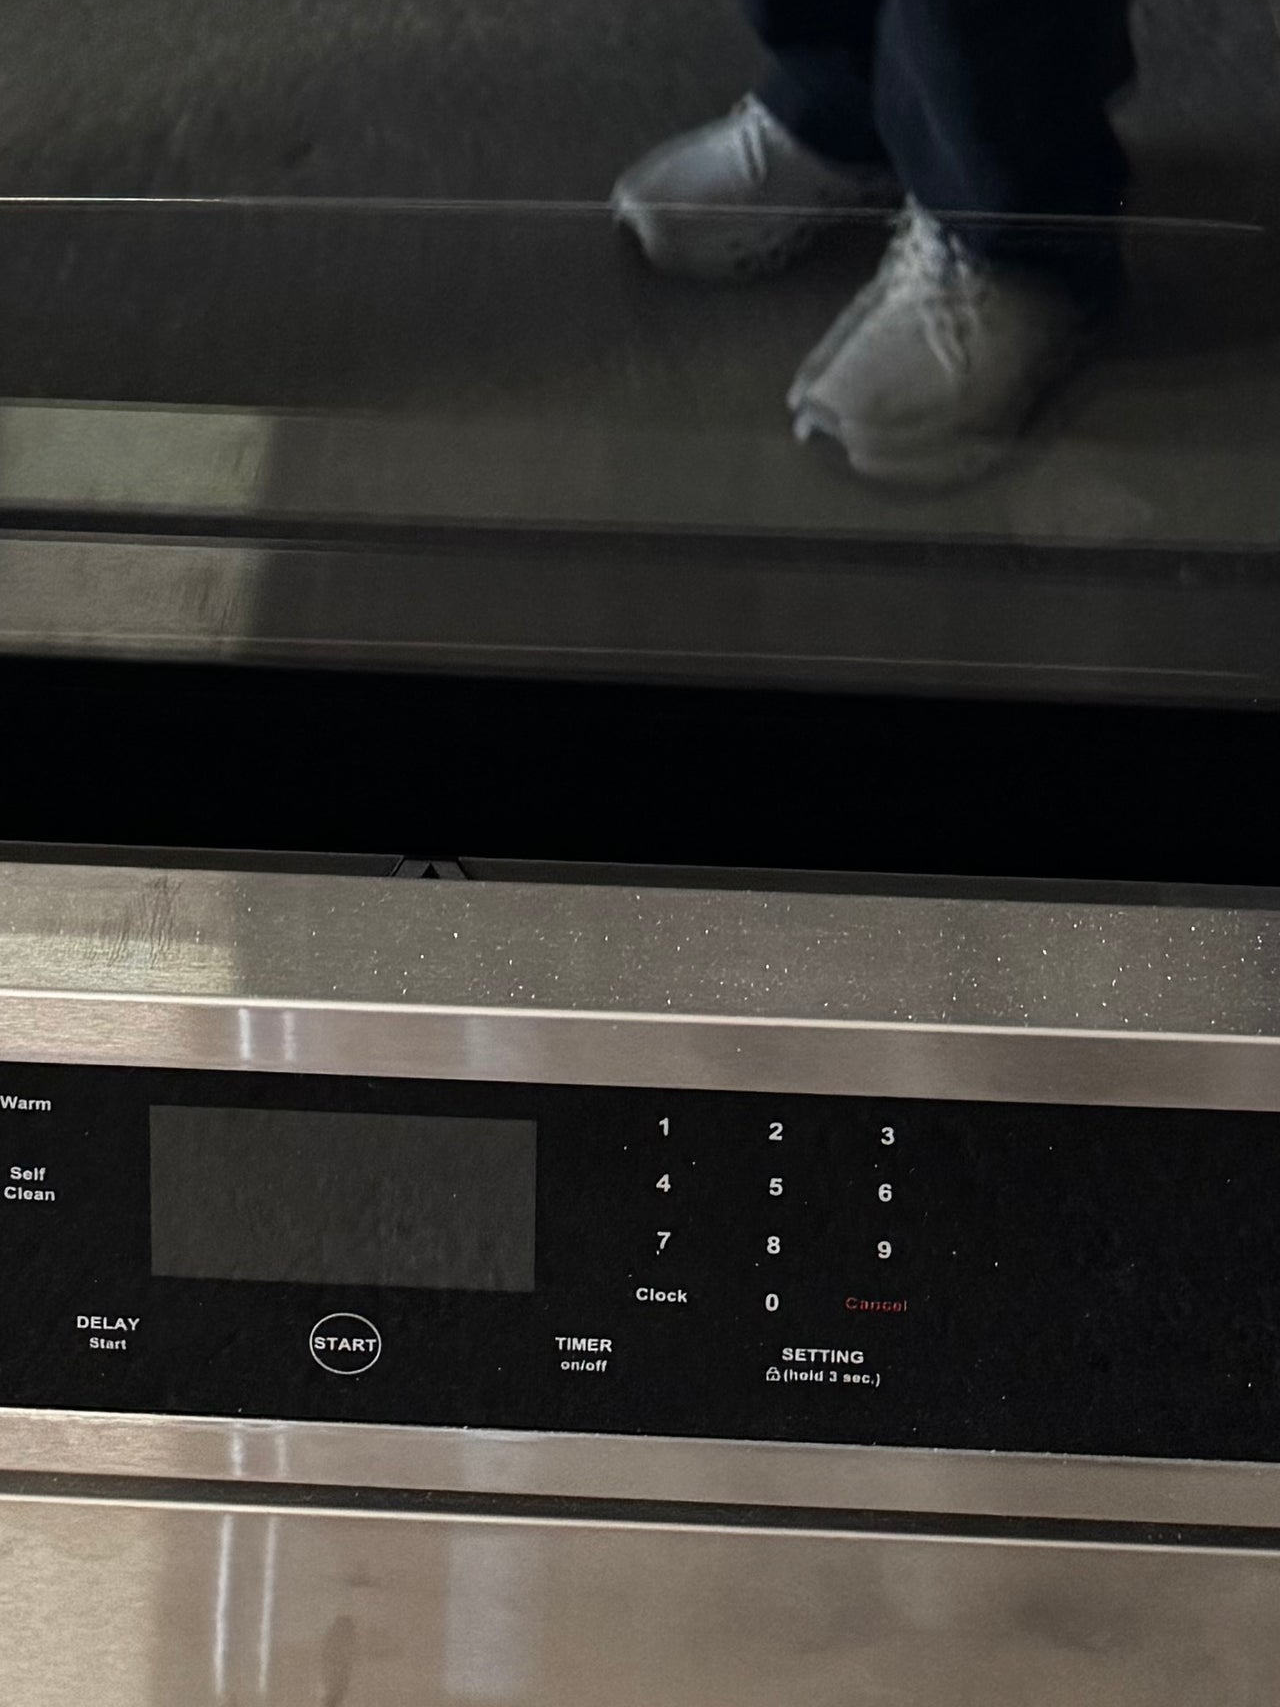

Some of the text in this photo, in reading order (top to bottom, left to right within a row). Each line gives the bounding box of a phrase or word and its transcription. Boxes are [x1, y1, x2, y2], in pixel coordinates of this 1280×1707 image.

[0, 1095, 52, 1111] Warm
[658, 1117, 669, 1137] 1
[768, 1122, 784, 1141] 2
[880, 1126, 895, 1146] 3
[10, 1166, 46, 1182] Self
[655, 1173, 671, 1193] 4
[3, 1186, 56, 1202] Clean
[769, 1177, 783, 1196] 5
[878, 1183, 893, 1203] 6
[656, 1231, 671, 1249] 7
[766, 1235, 781, 1255] 8
[877, 1240, 892, 1259] 9
[635, 1287, 688, 1303] Clock
[765, 1293, 780, 1312] 0
[845, 1297, 907, 1312] Cancel
[76, 1315, 140, 1331] DELAY
[89, 1336, 127, 1350] Start
[313, 1335, 377, 1353] START
[554, 1336, 612, 1353] TIMER
[781, 1347, 864, 1364] SETTING
[560, 1359, 608, 1372] on/off
[782, 1367, 881, 1388] (hold 3 sec.)
